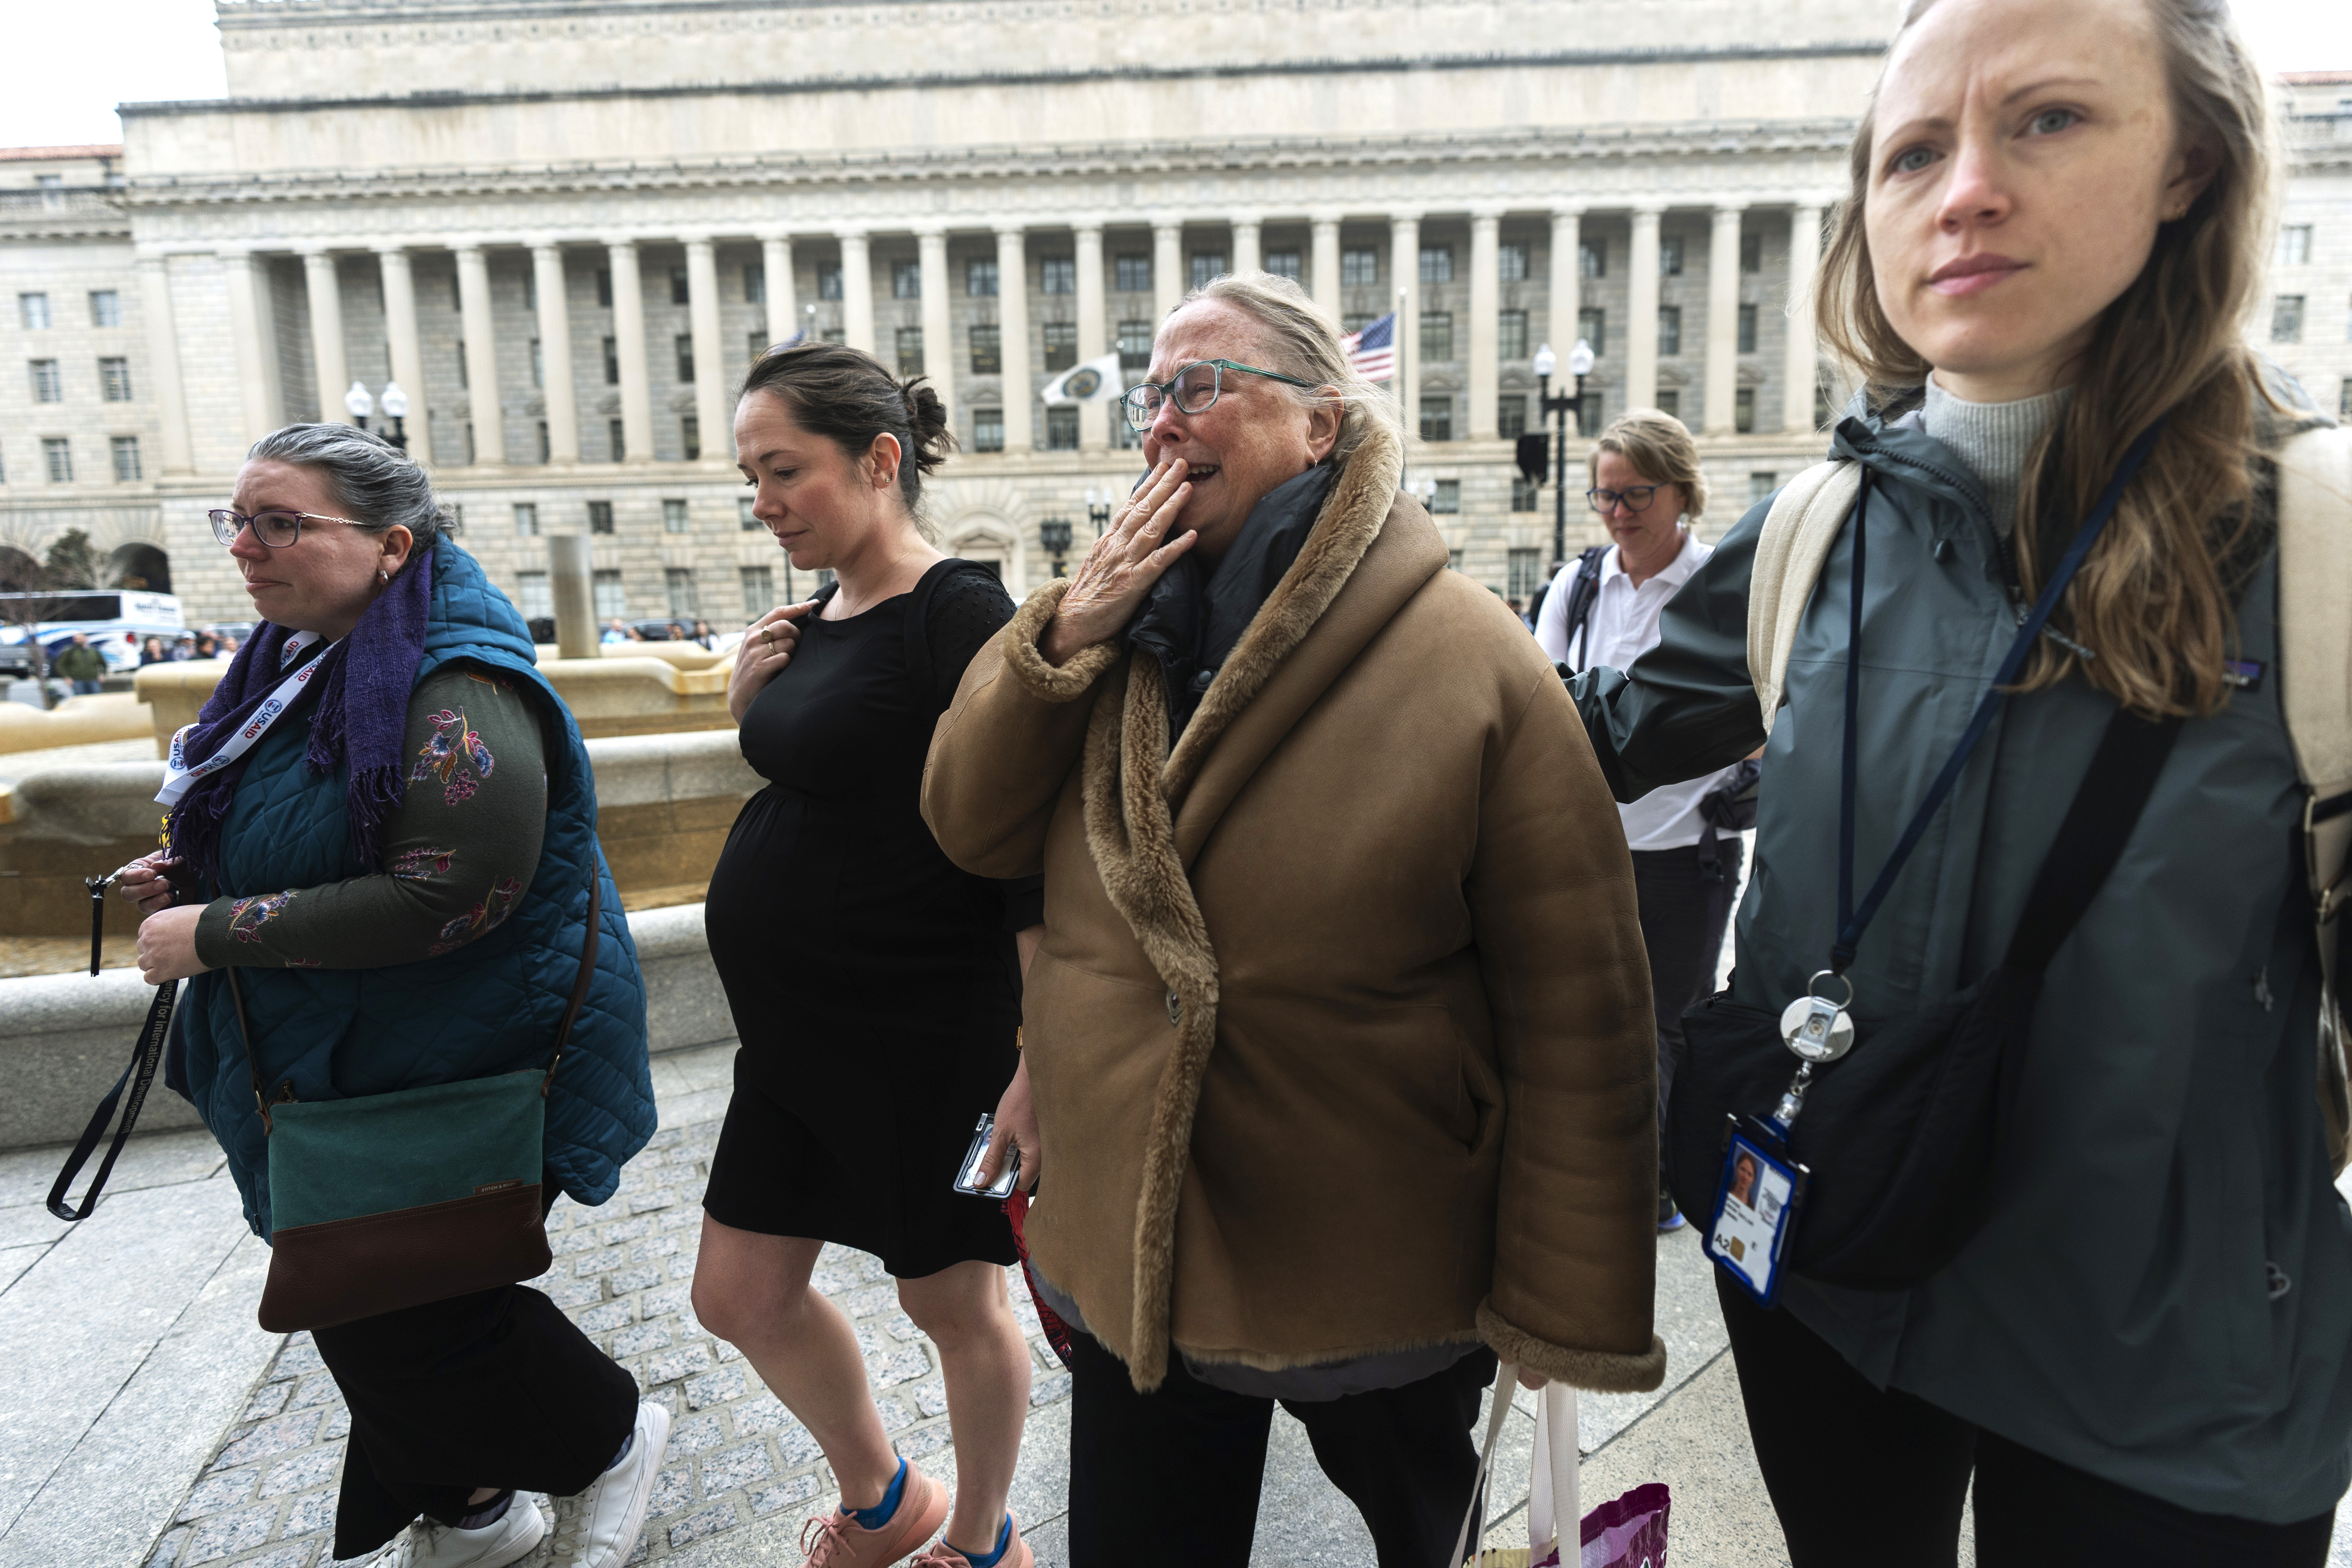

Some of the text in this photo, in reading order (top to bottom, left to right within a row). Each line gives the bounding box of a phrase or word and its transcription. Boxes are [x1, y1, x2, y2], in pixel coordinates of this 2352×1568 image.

[280, 641, 299, 665] USAID
[245, 712, 272, 739] USAID
[190, 763, 219, 777] USAID
[121, 980, 174, 1134] ency for International Development
[1715, 1233, 1730, 1251] A2
